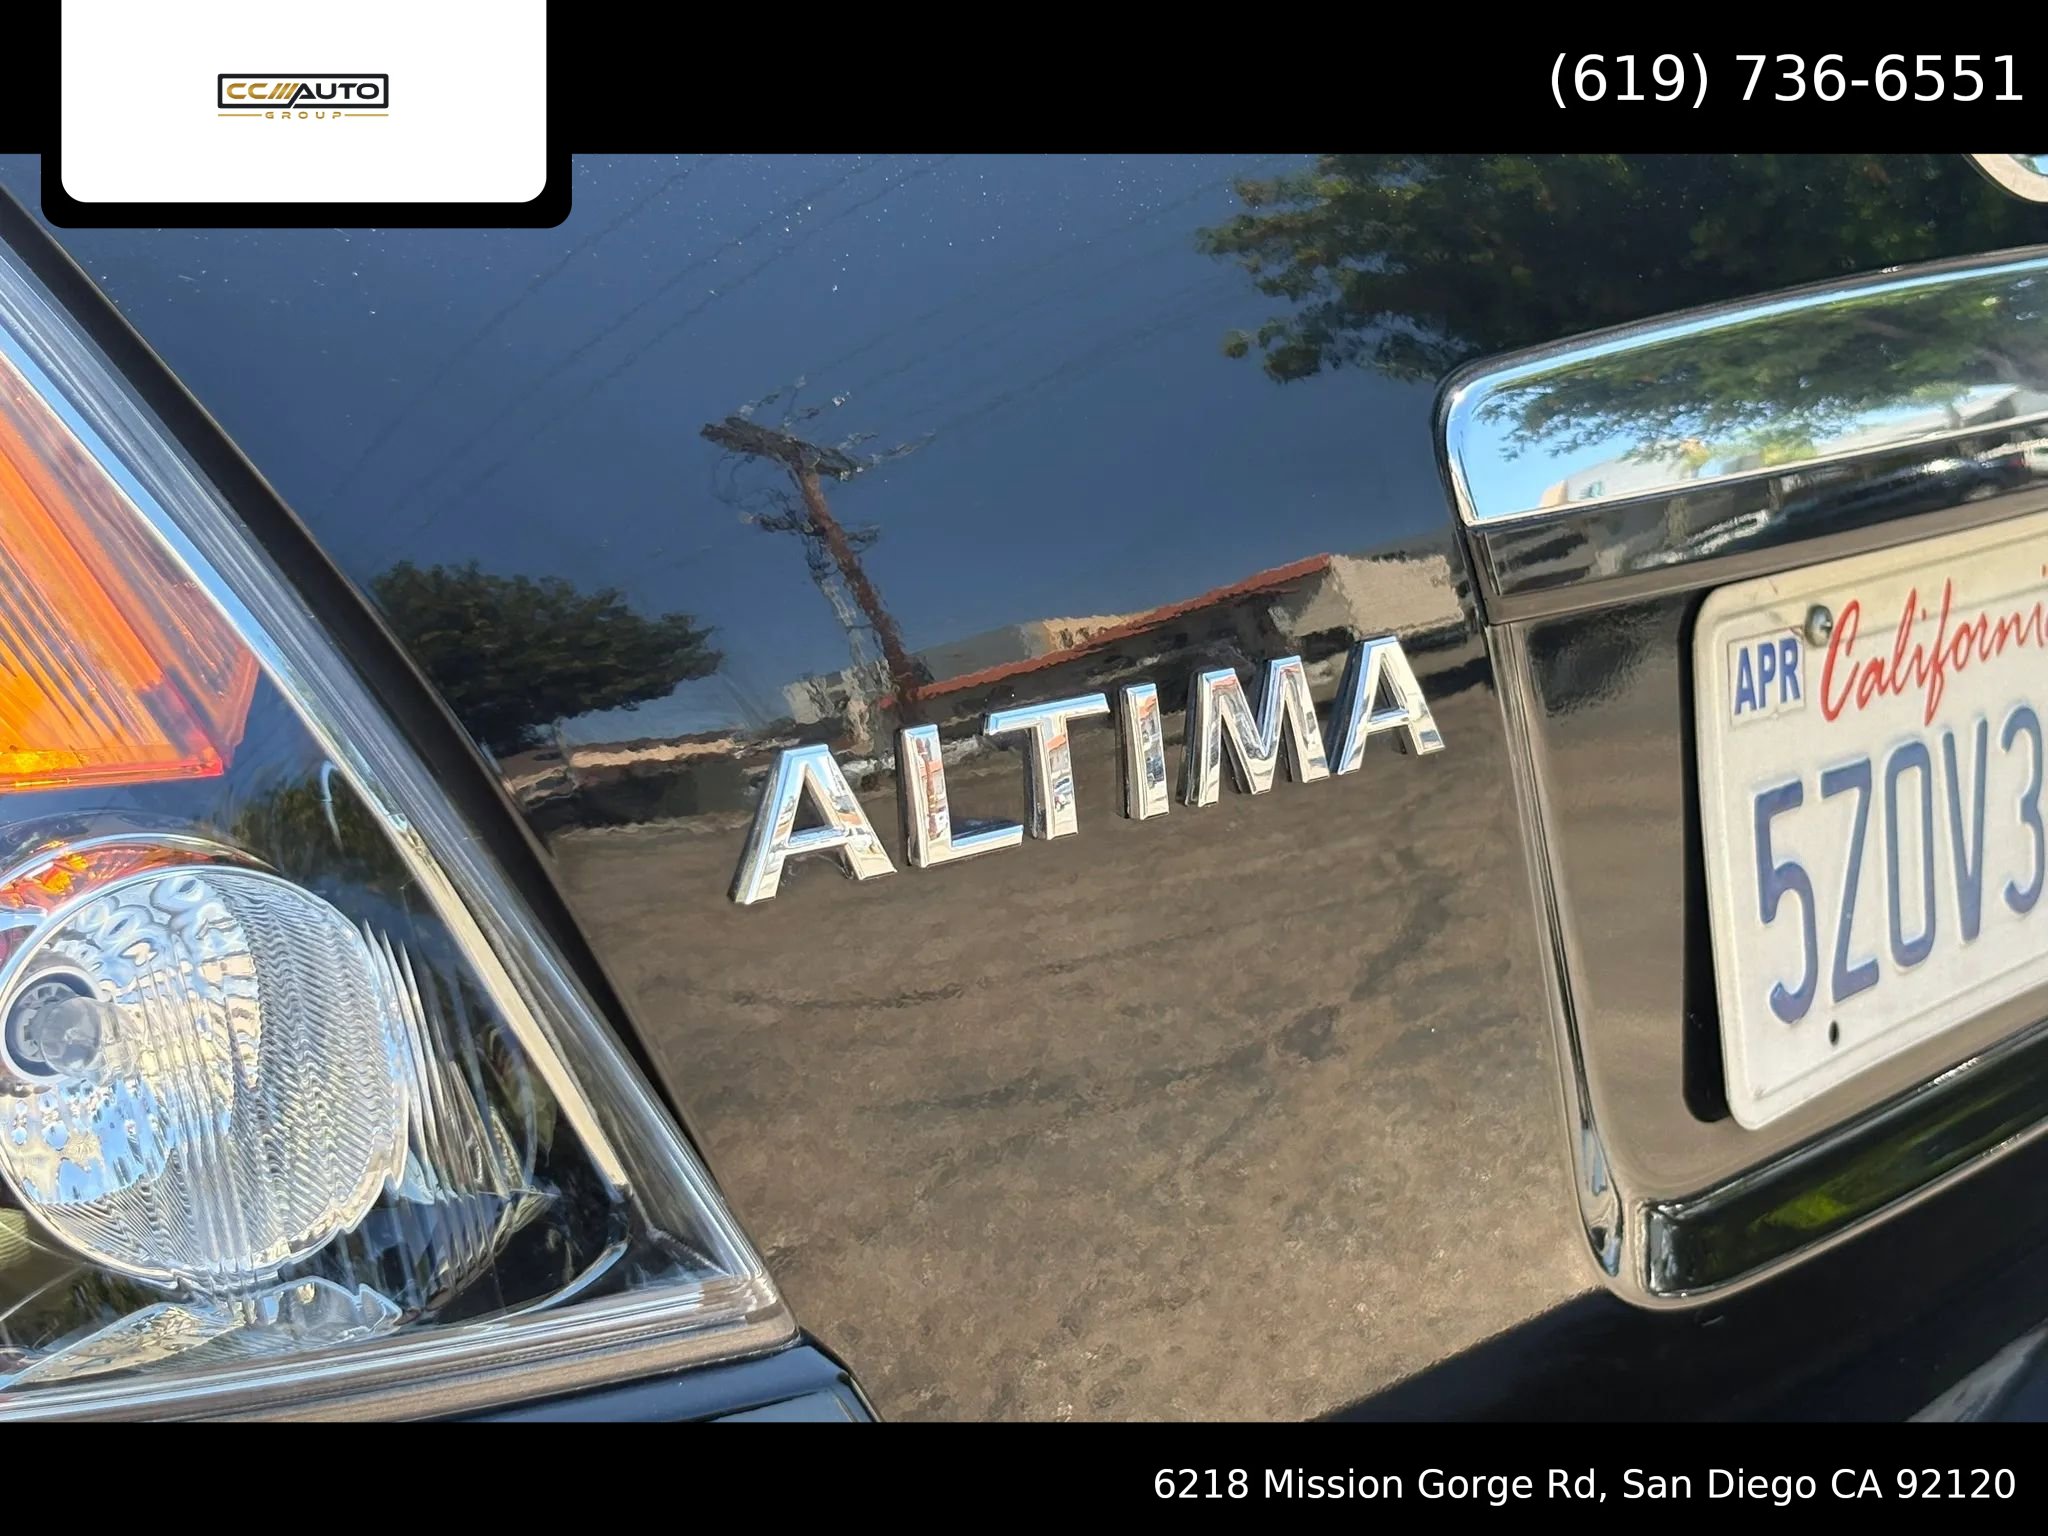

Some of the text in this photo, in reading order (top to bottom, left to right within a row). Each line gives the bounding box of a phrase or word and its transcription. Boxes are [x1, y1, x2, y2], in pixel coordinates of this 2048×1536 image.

[1734, 637, 1801, 716] APR
[1819, 565, 2048, 727] Californi
[728, 636, 1446, 905] ALTIMA
